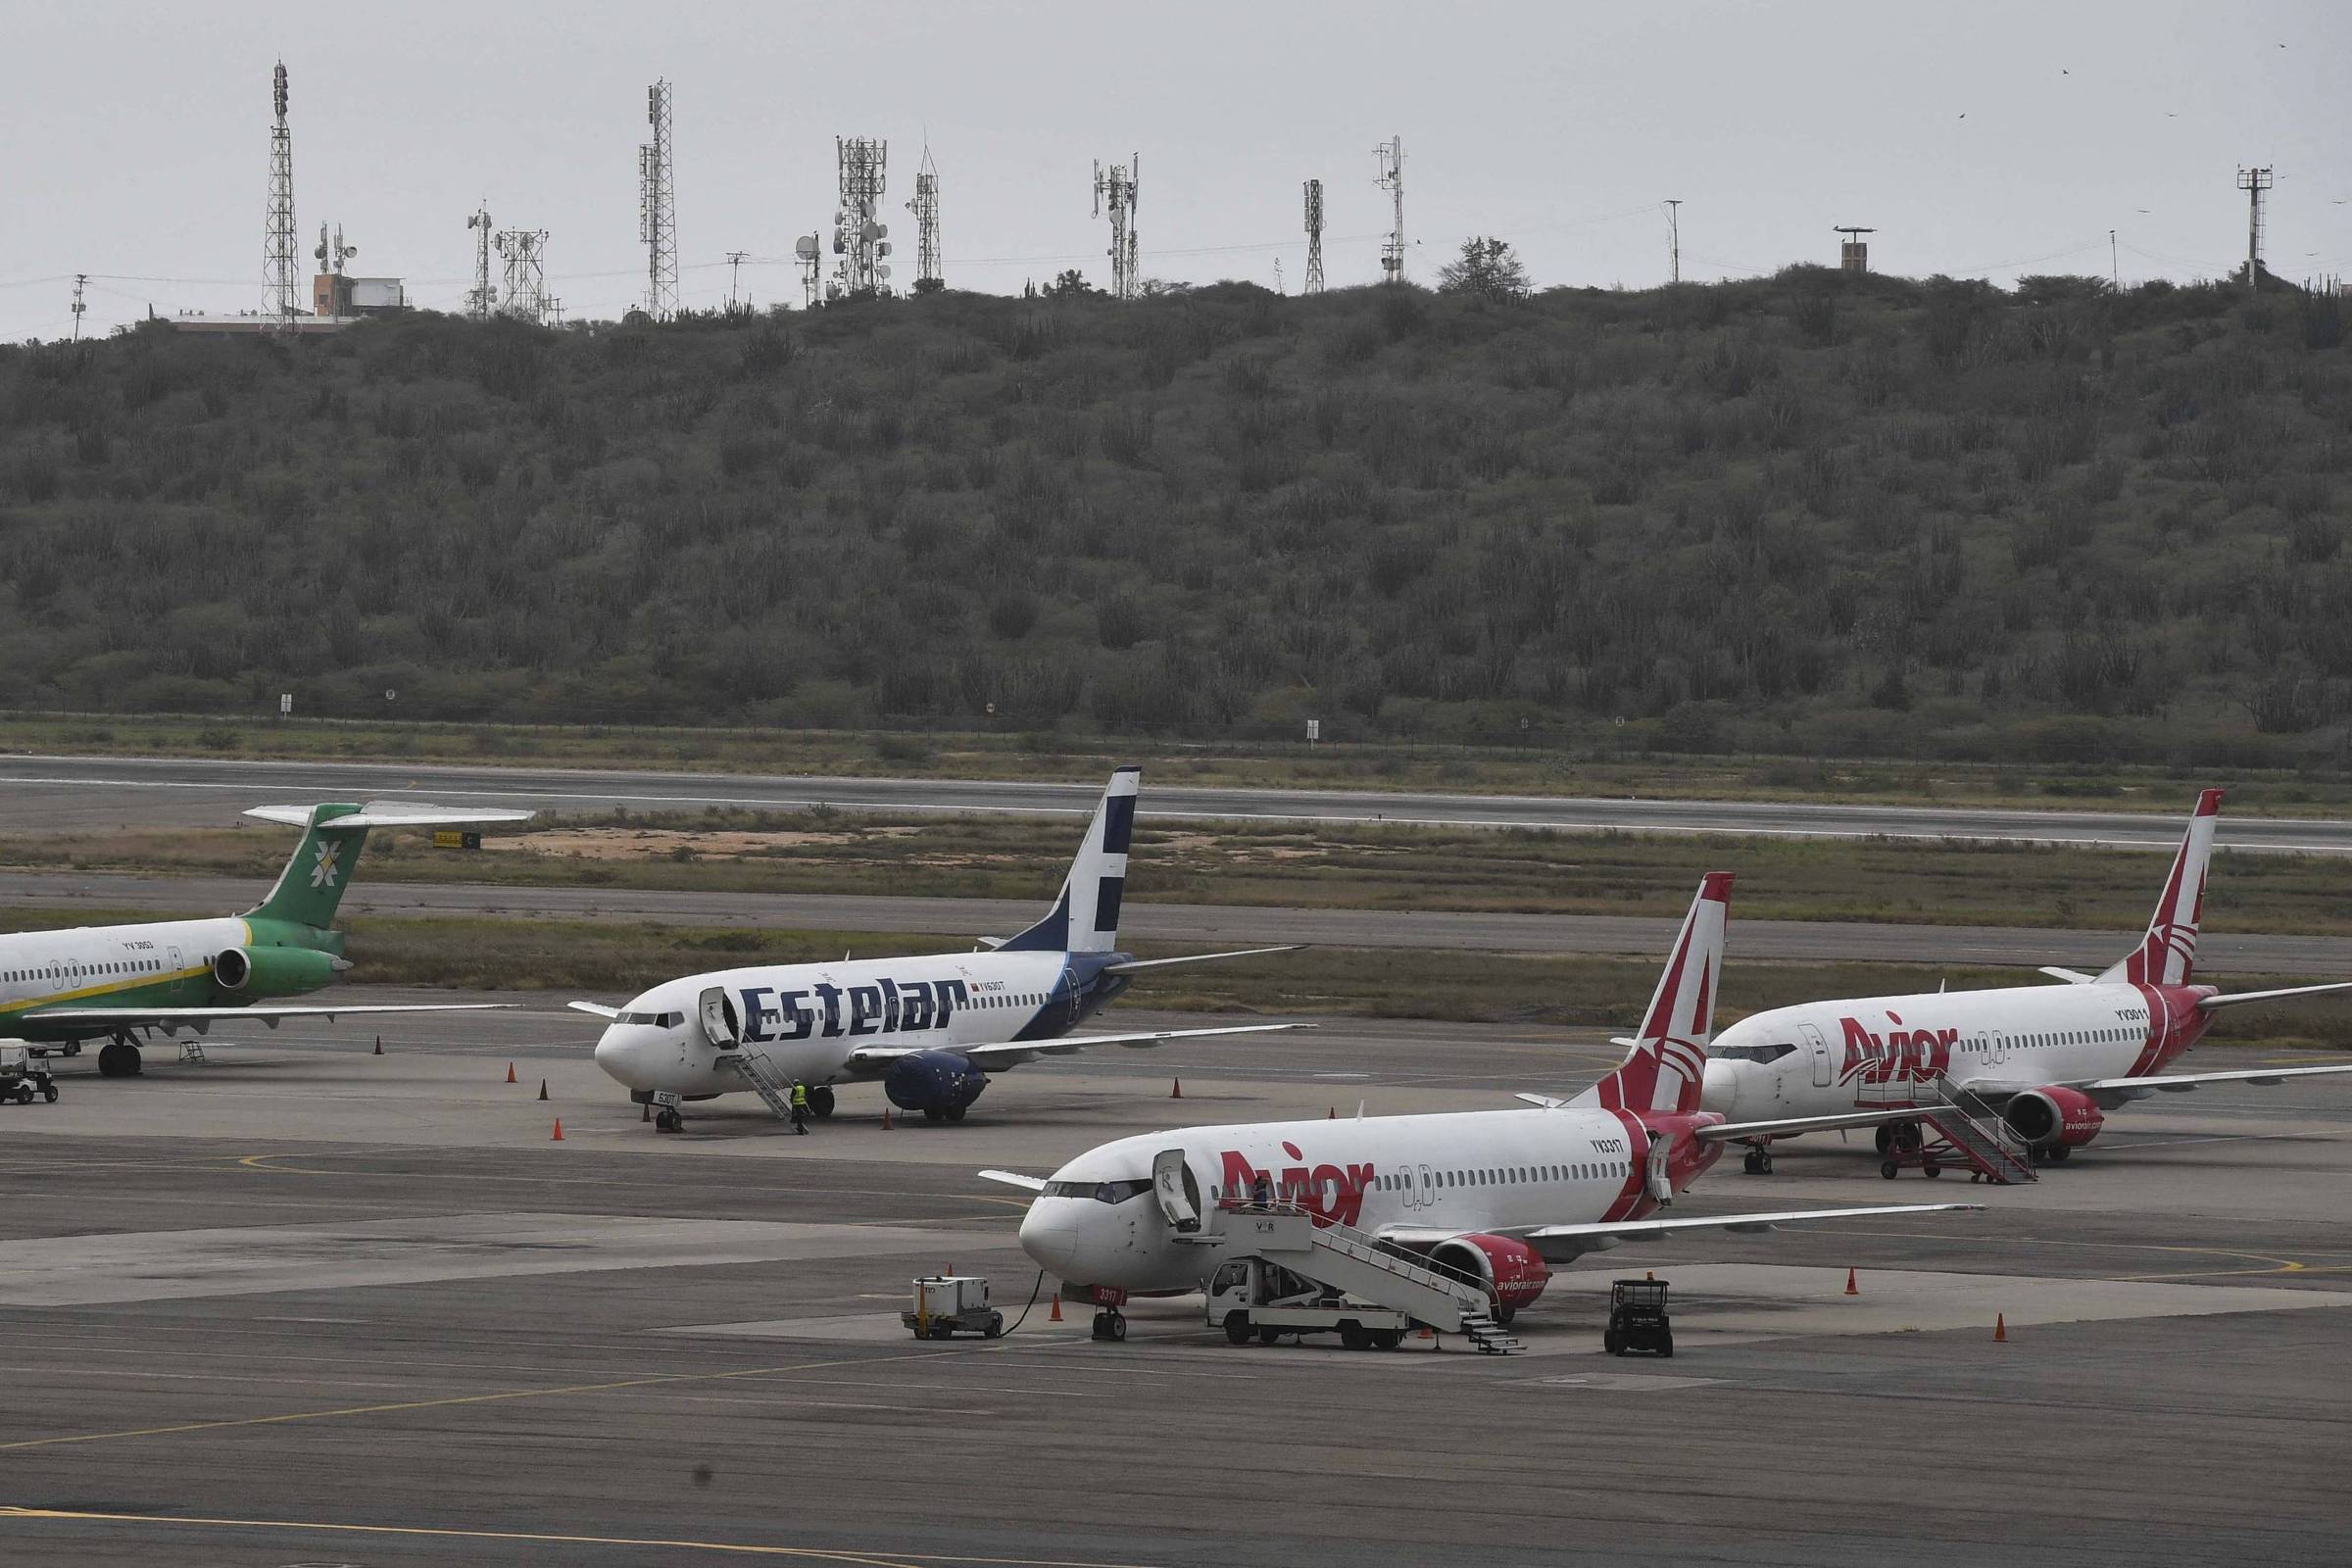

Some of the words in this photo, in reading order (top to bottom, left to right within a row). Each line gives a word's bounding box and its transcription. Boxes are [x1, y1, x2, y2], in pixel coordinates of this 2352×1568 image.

[122, 942, 135, 951] YV
[979, 981, 1005, 991] YV630T
[739, 978, 968, 1043] Estelar
[2114, 1008, 2149, 1020] YV3011
[1838, 1010, 1958, 1087] Avior
[658, 1092, 675, 1104] 630T
[1590, 1139, 1624, 1153] YV3317
[1100, 1287, 1116, 1301] 3317
